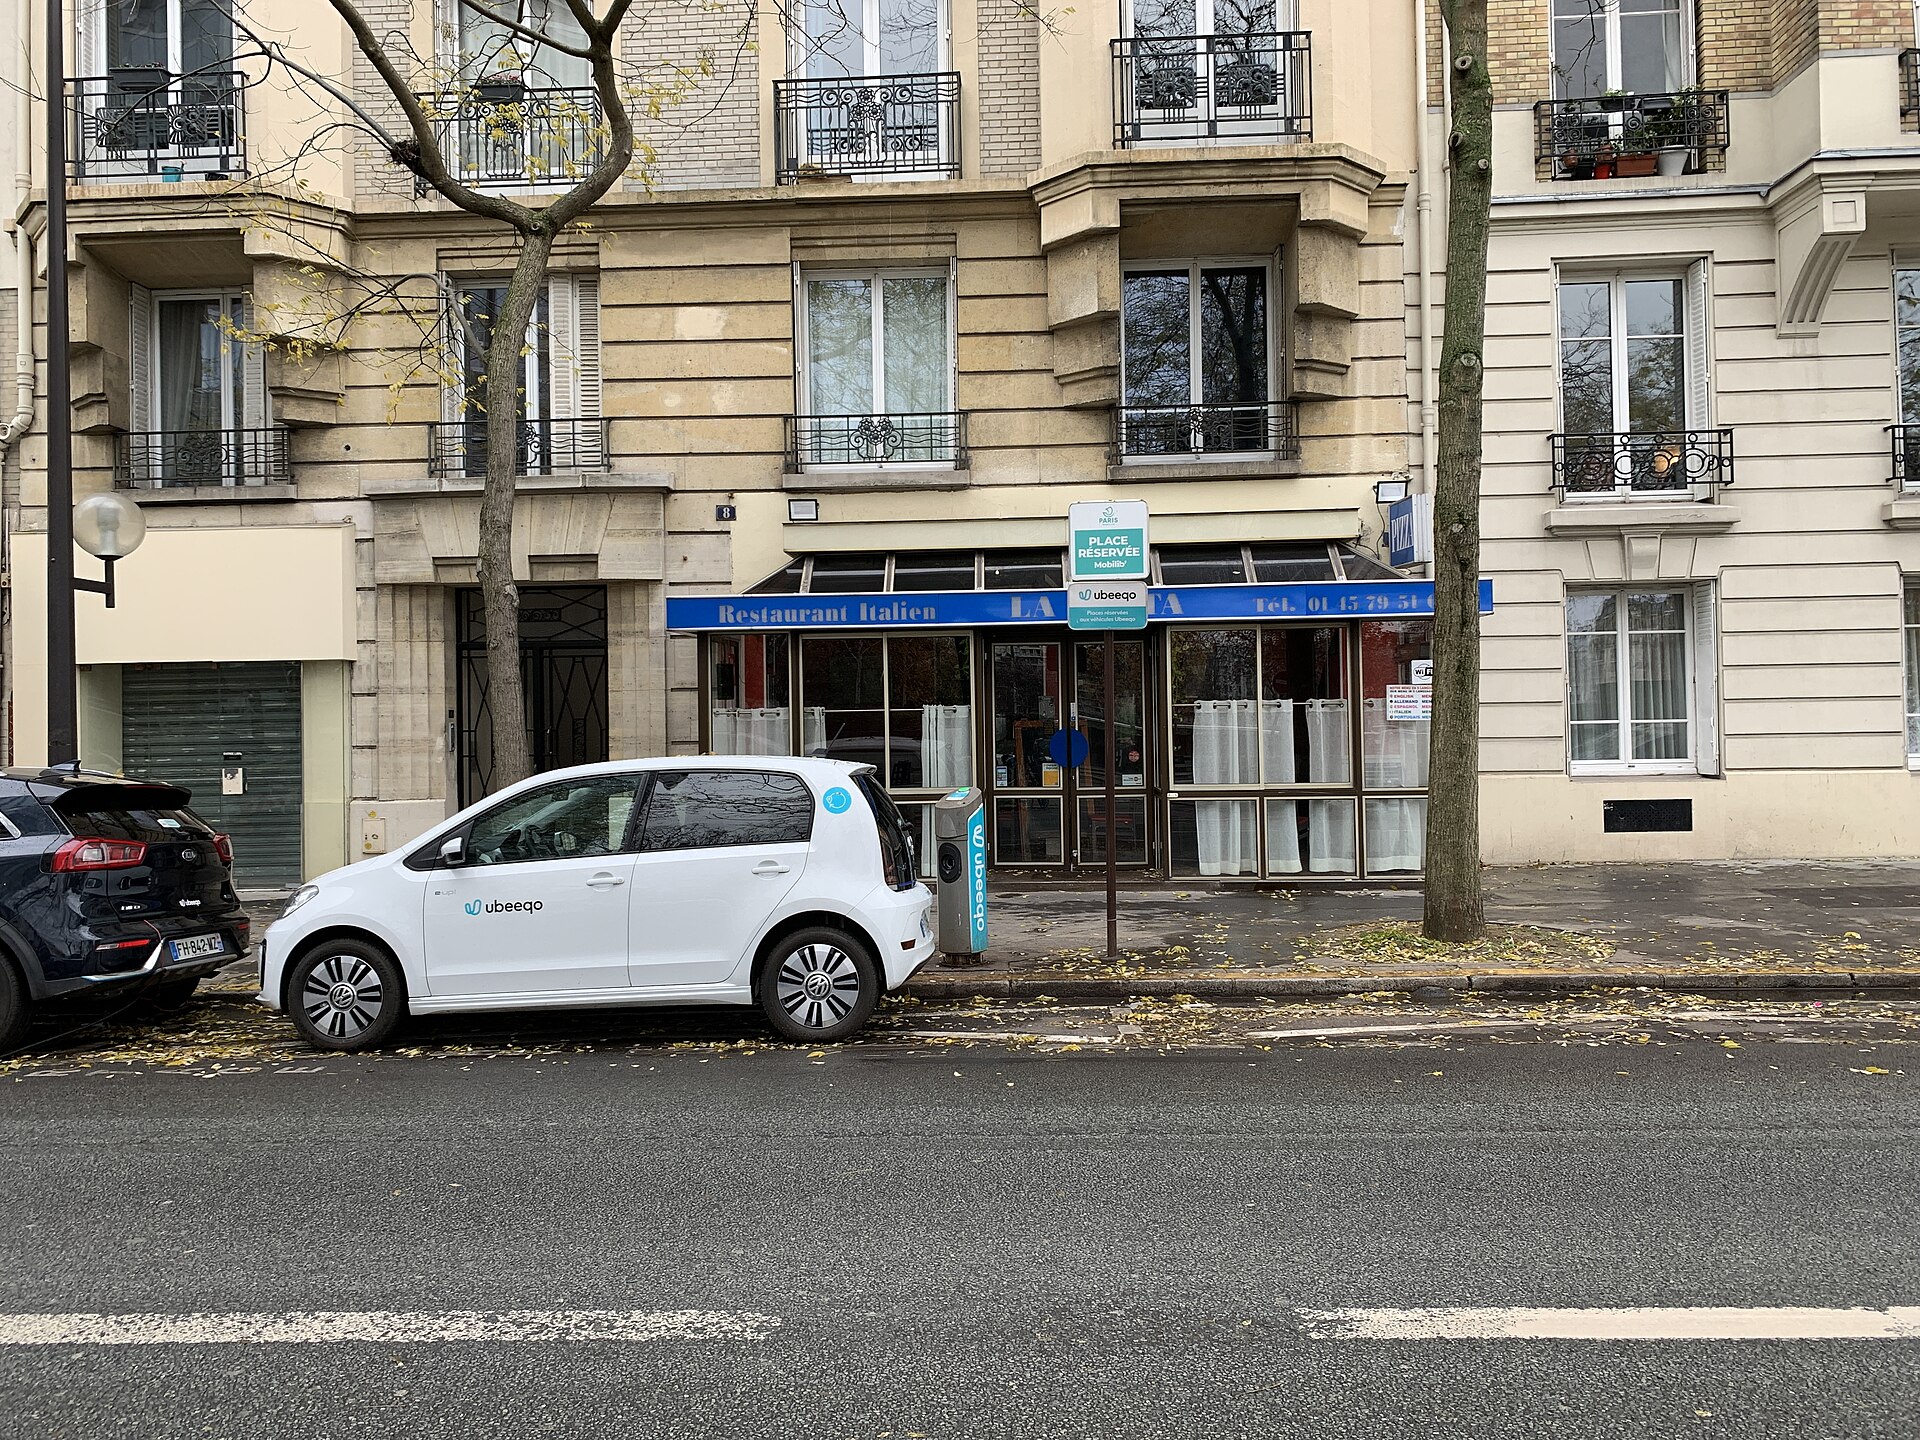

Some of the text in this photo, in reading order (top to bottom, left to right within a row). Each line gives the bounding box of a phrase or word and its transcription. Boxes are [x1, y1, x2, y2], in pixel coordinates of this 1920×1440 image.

[722, 507, 730, 518] 8
[1391, 512, 1414, 553] PIZZA
[1088, 536, 1128, 546] PLACE
[1078, 545, 1140, 558] RÉSERVÉE
[1094, 590, 1136, 602] ubeeqo
[718, 604, 848, 624] Restaurant
[859, 601, 936, 621] Italien
[1011, 595, 1056, 618] LA
[1254, 596, 1296, 612] Tél.
[1308, 596, 1329, 612] 01
[1339, 596, 1358, 611] 45
[1366, 594, 1388, 610] 79
[1398, 594, 1417, 609] 51
[974, 852, 985, 932] ubeeqo
[486, 900, 543, 914] ubeeqo
